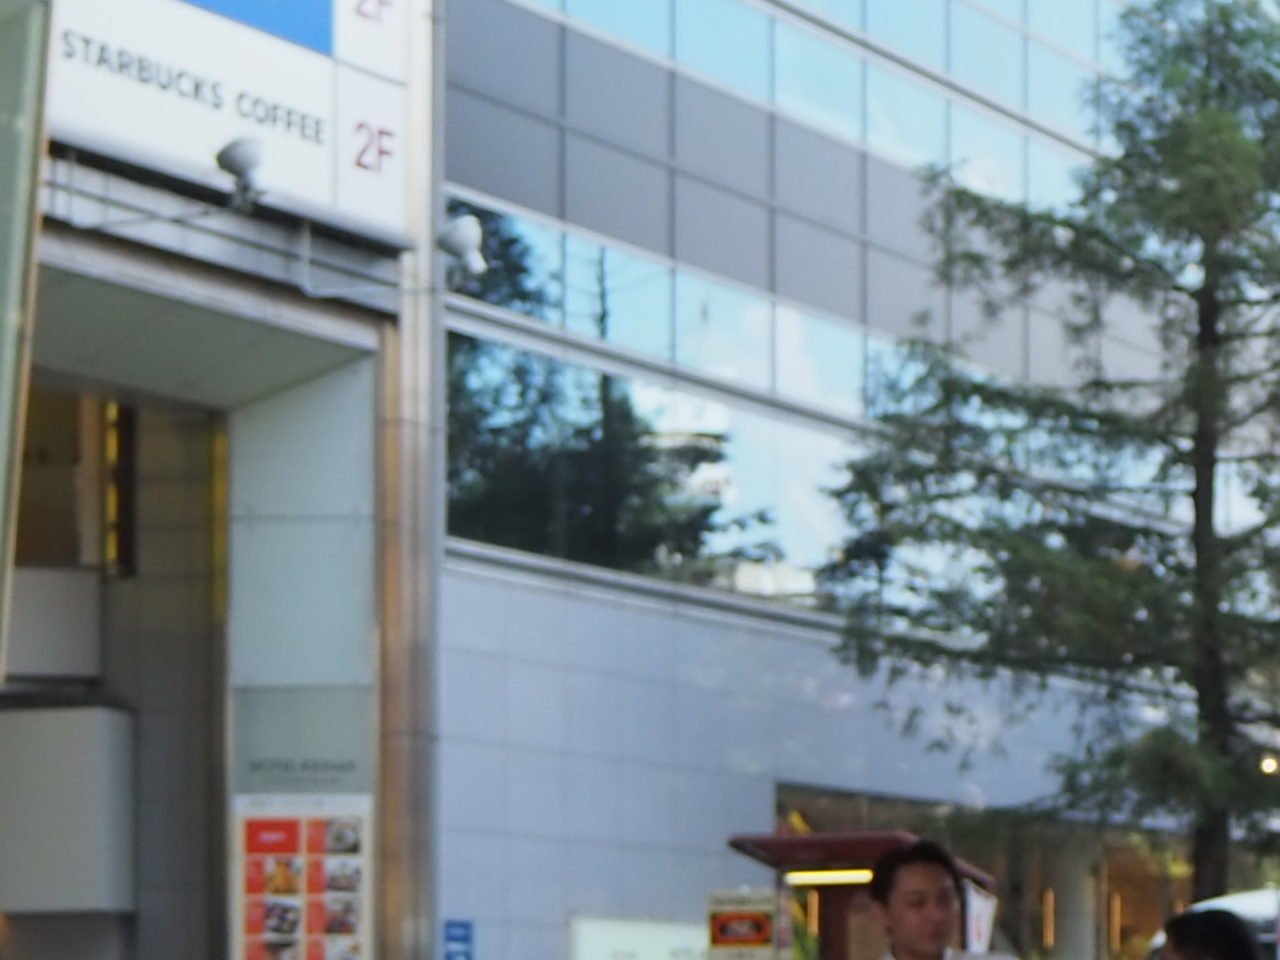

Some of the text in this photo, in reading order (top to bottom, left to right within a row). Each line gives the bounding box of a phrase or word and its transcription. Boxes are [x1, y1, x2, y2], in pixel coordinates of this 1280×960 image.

[62, 30, 326, 145] STARBUCKS COFFEE
[354, 121, 395, 172] 2F
